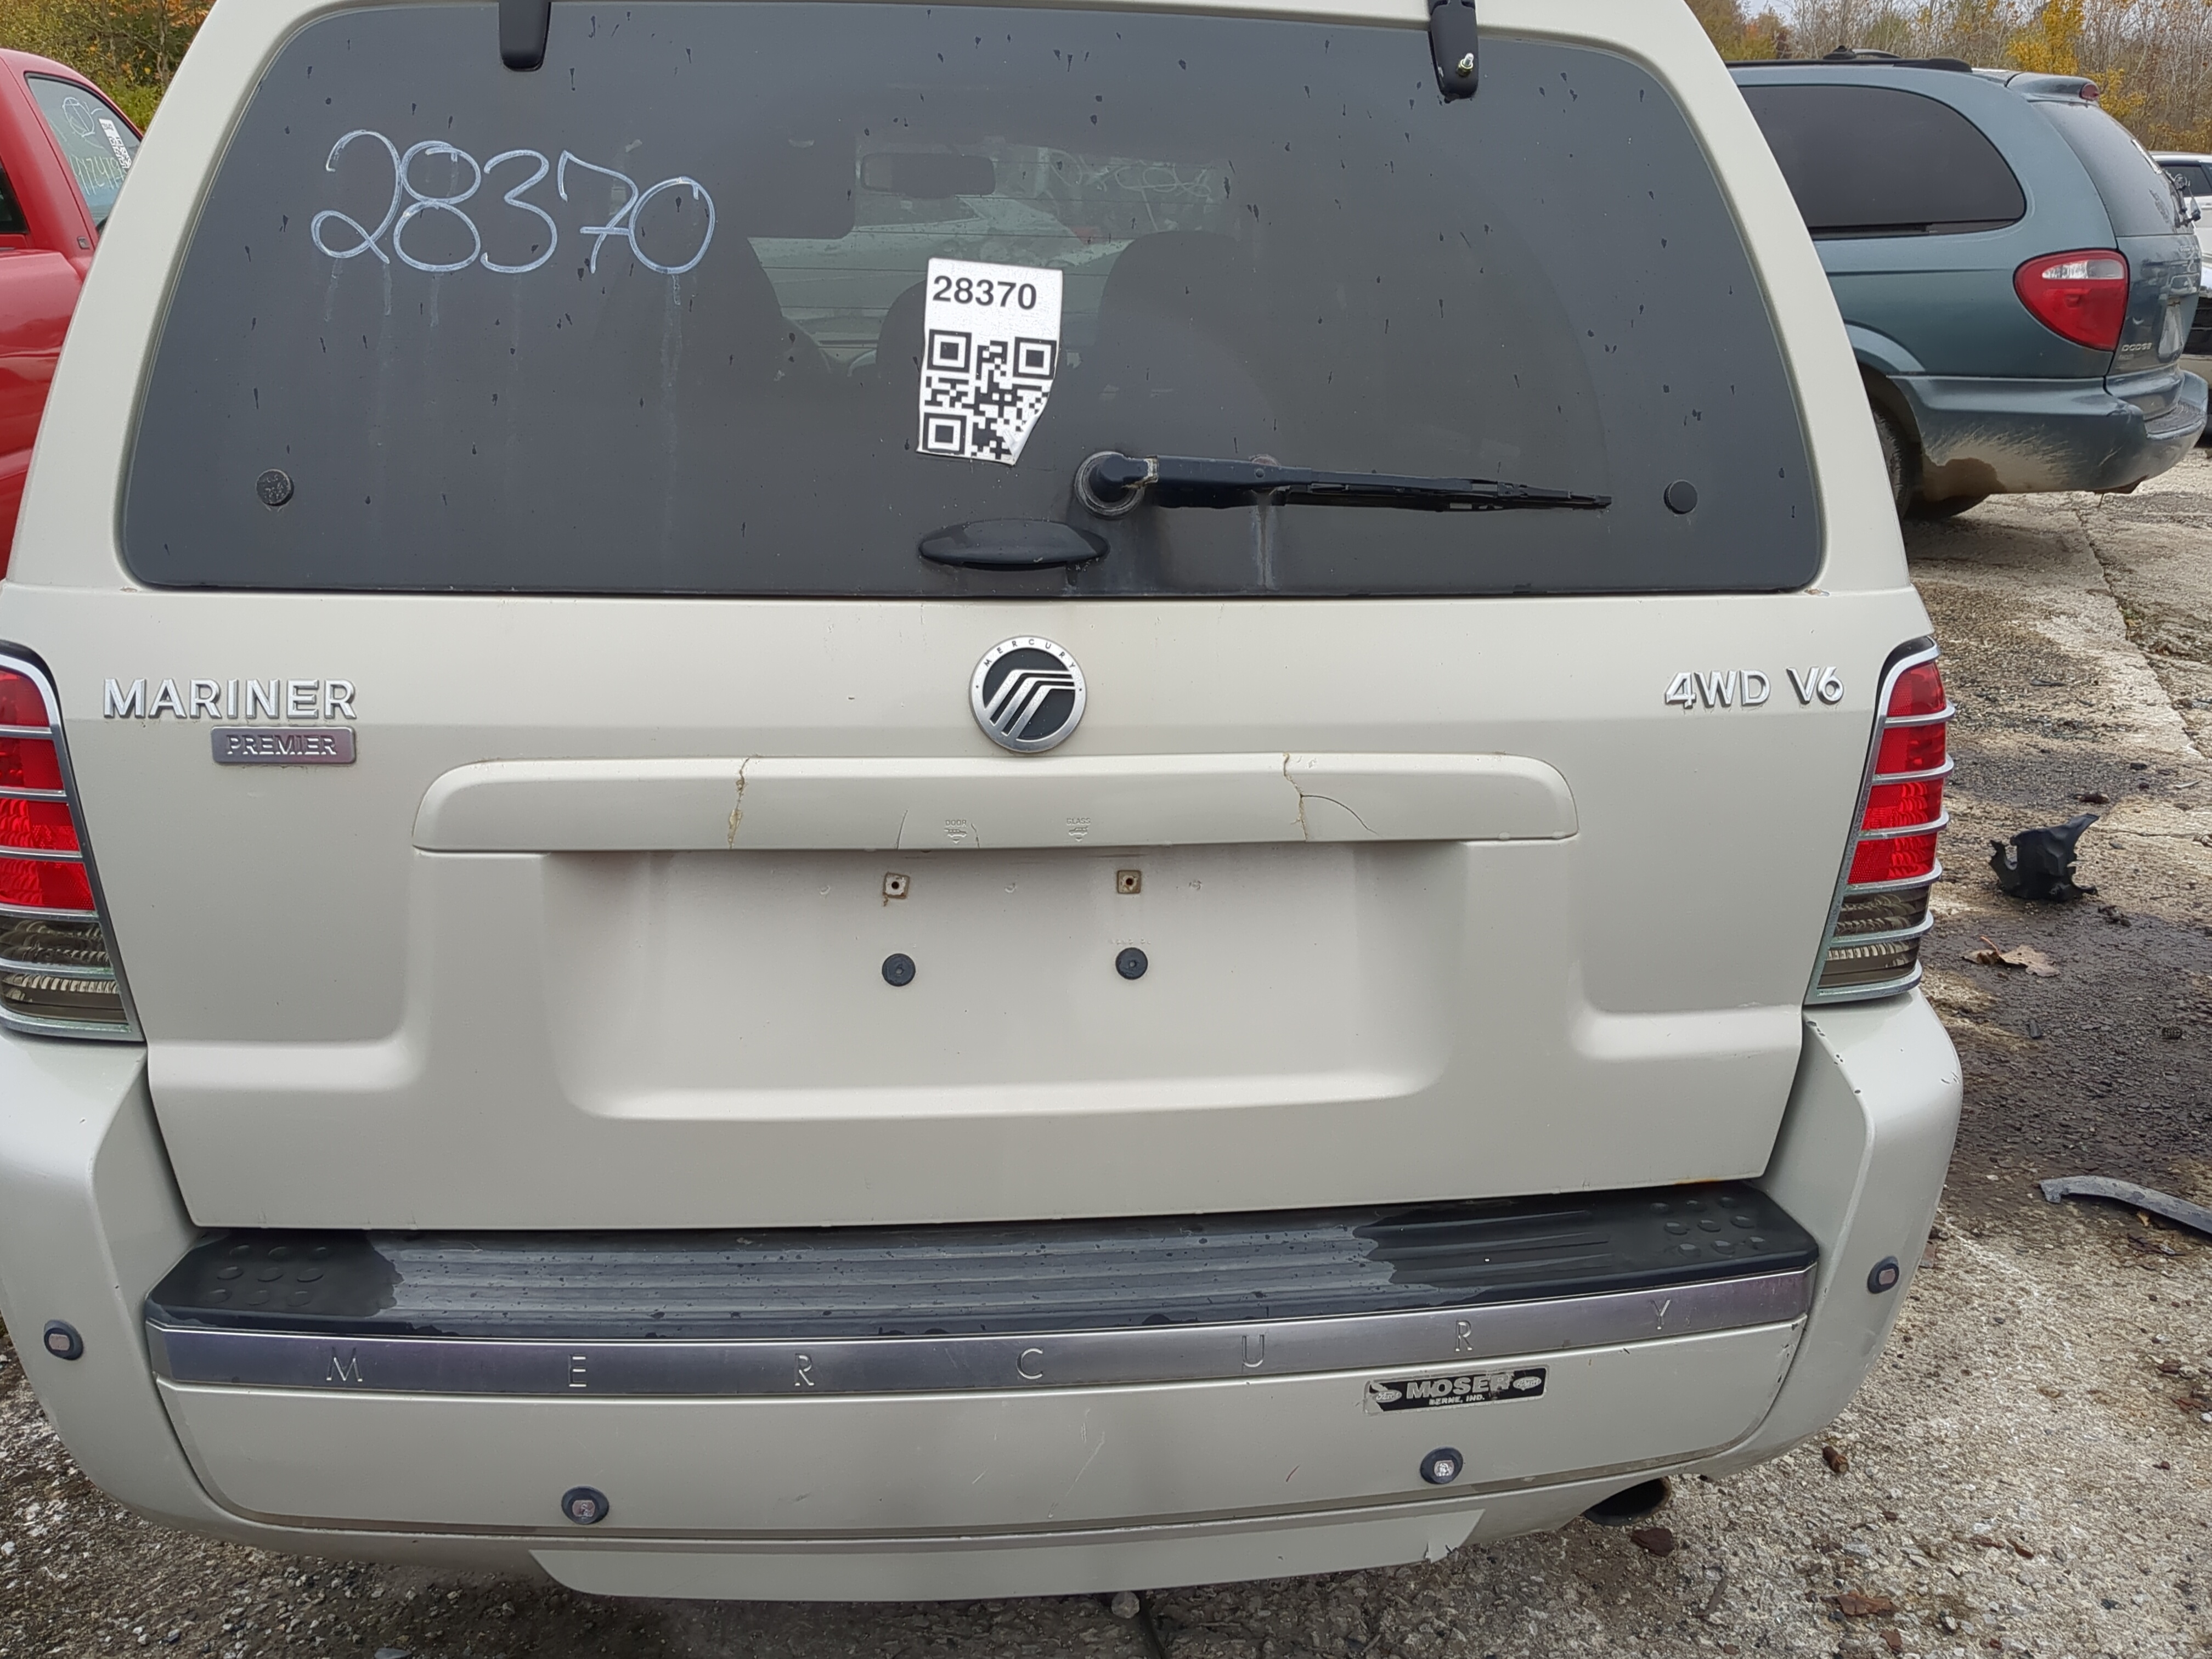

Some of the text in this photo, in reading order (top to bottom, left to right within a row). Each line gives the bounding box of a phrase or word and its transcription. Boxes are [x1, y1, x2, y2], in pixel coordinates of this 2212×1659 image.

[311, 128, 715, 274] 28370
[932, 275, 1037, 310] 28370
[983, 638, 1076, 668] MERCURY
[103, 678, 358, 720] MARINER
[1664, 665, 1844, 709] 4WD V6
[225, 733, 337, 755] PREMIER
[1066, 817, 1092, 826] GLASS
[1406, 1374, 1510, 1399] MOSER
[1466, 1393, 1485, 1402] IND.
